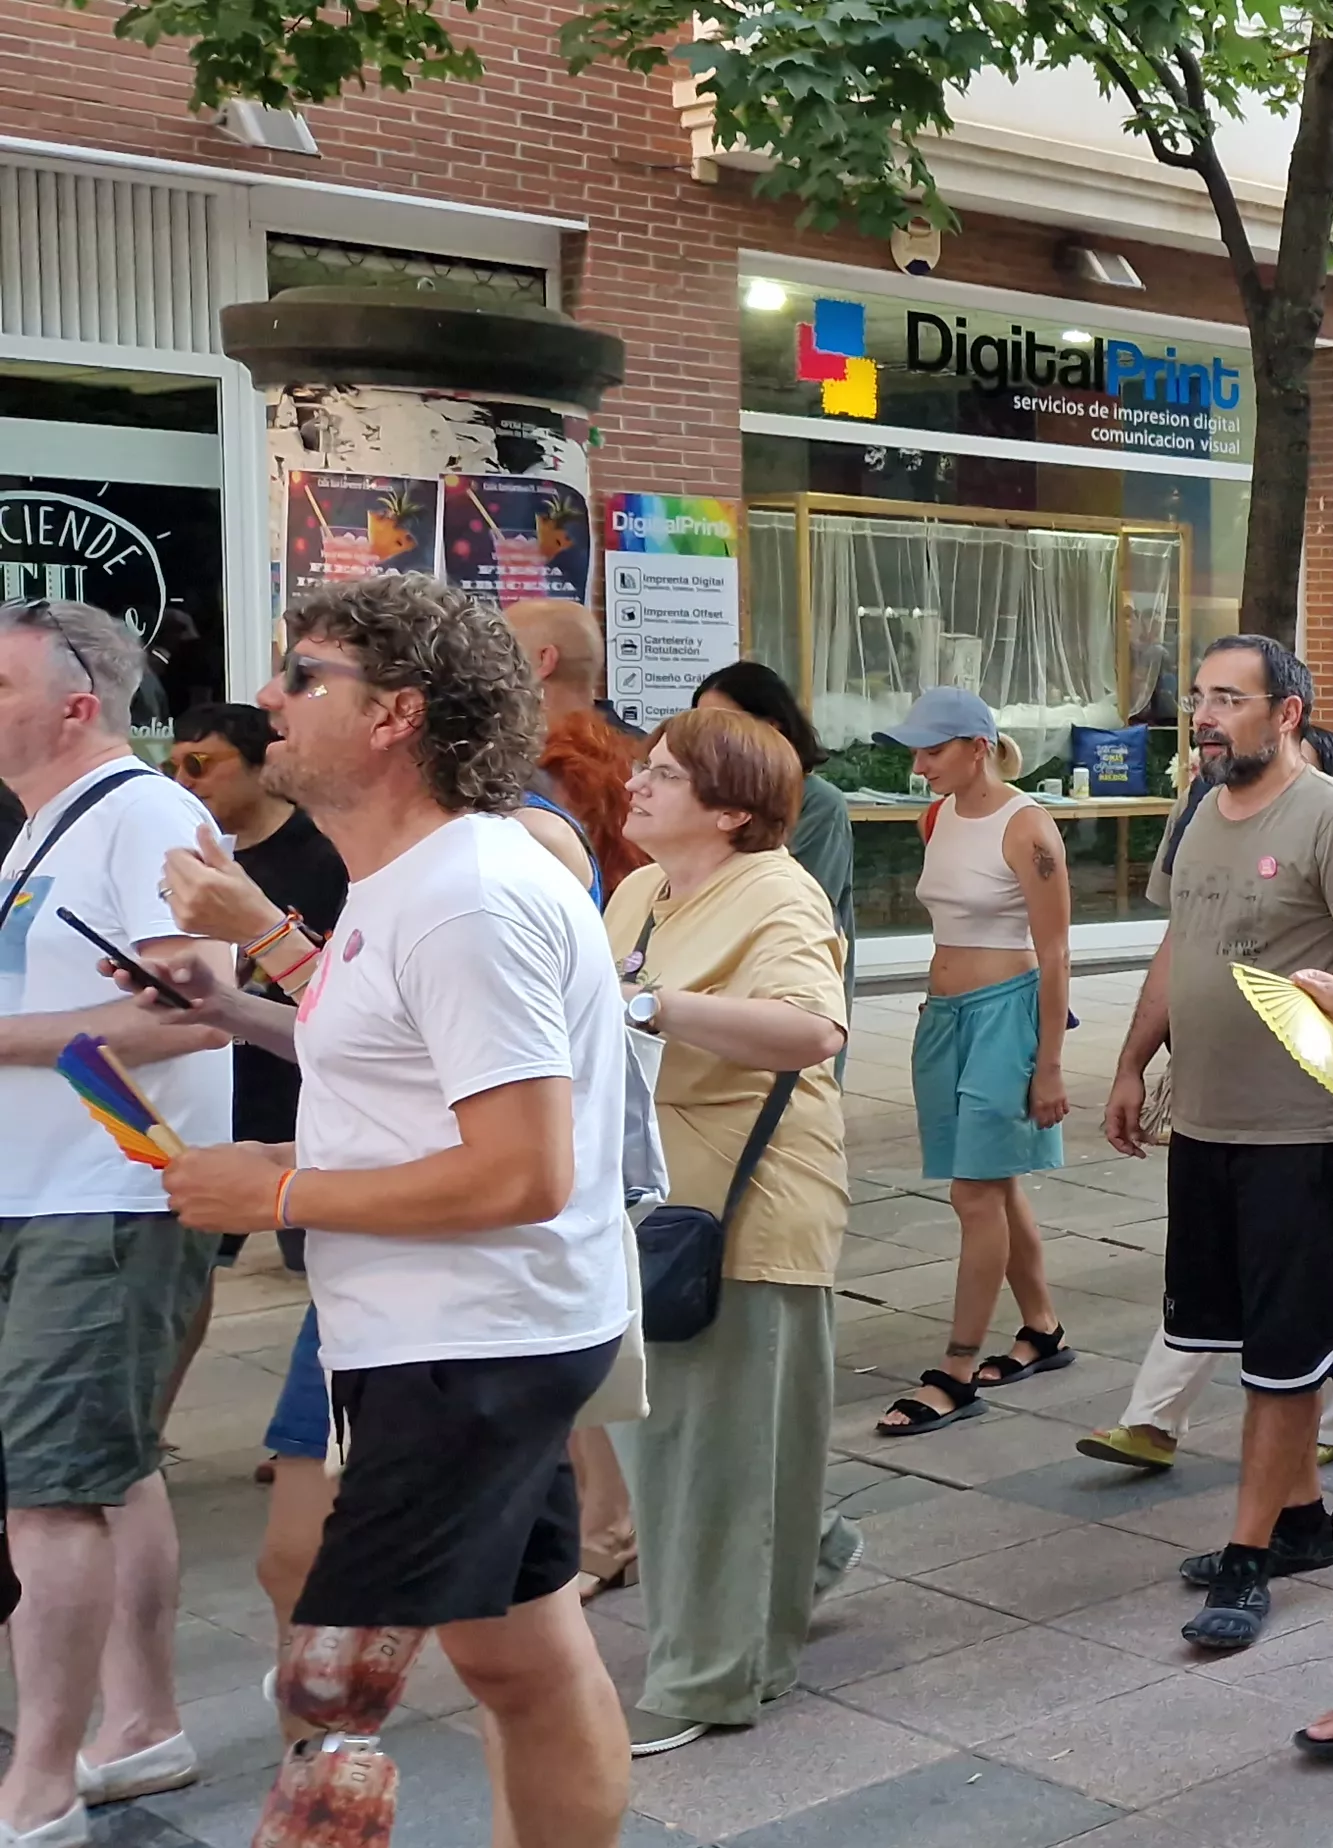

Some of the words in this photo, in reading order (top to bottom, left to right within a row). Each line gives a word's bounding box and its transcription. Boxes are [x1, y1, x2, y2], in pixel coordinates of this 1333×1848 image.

[906, 310, 1241, 409] DigitalPrint
[1013, 395, 1085, 418] servicios
[1089, 401, 1109, 420] de
[1113, 404, 1190, 429] impresion
[1194, 413, 1240, 434] digital
[1091, 427, 1194, 451] comunicacion
[1200, 436, 1240, 455] visual
[478, 564, 563, 576] FIESTA
[643, 574, 689, 585] Imprenta
[692, 576, 724, 588] Digital
[644, 607, 690, 617] Imprenta
[693, 608, 723, 619] Offset
[644, 635, 694, 646] Cartelería
[698, 638, 703, 647] y
[645, 645, 700, 656] Rotulación
[645, 673, 681, 682] Diseño
